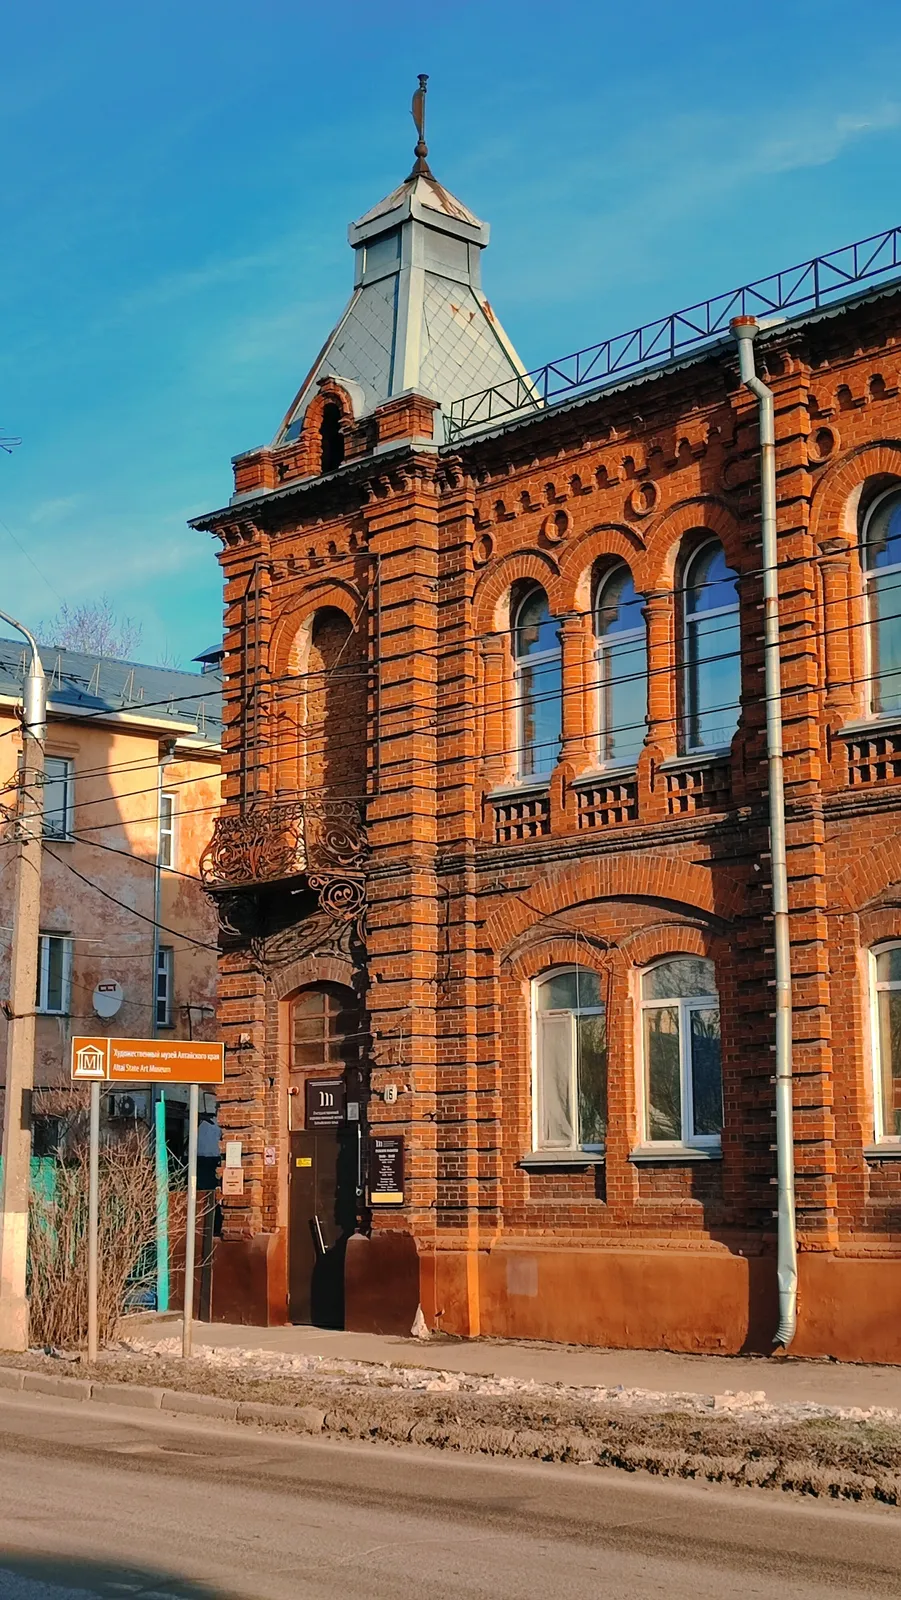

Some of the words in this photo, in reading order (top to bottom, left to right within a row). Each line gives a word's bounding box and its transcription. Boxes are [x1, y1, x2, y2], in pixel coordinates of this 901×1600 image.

[161, 1051, 177, 1060] музей
[178, 1051, 206, 1060] Алтайского
[207, 1054, 220, 1062] края
[113, 1063, 125, 1072] Altai
[125, 1064, 140, 1073] State
[140, 1065, 149, 1073] Art
[150, 1065, 171, 1073] Museum
[386, 1088, 394, 1100] 16
